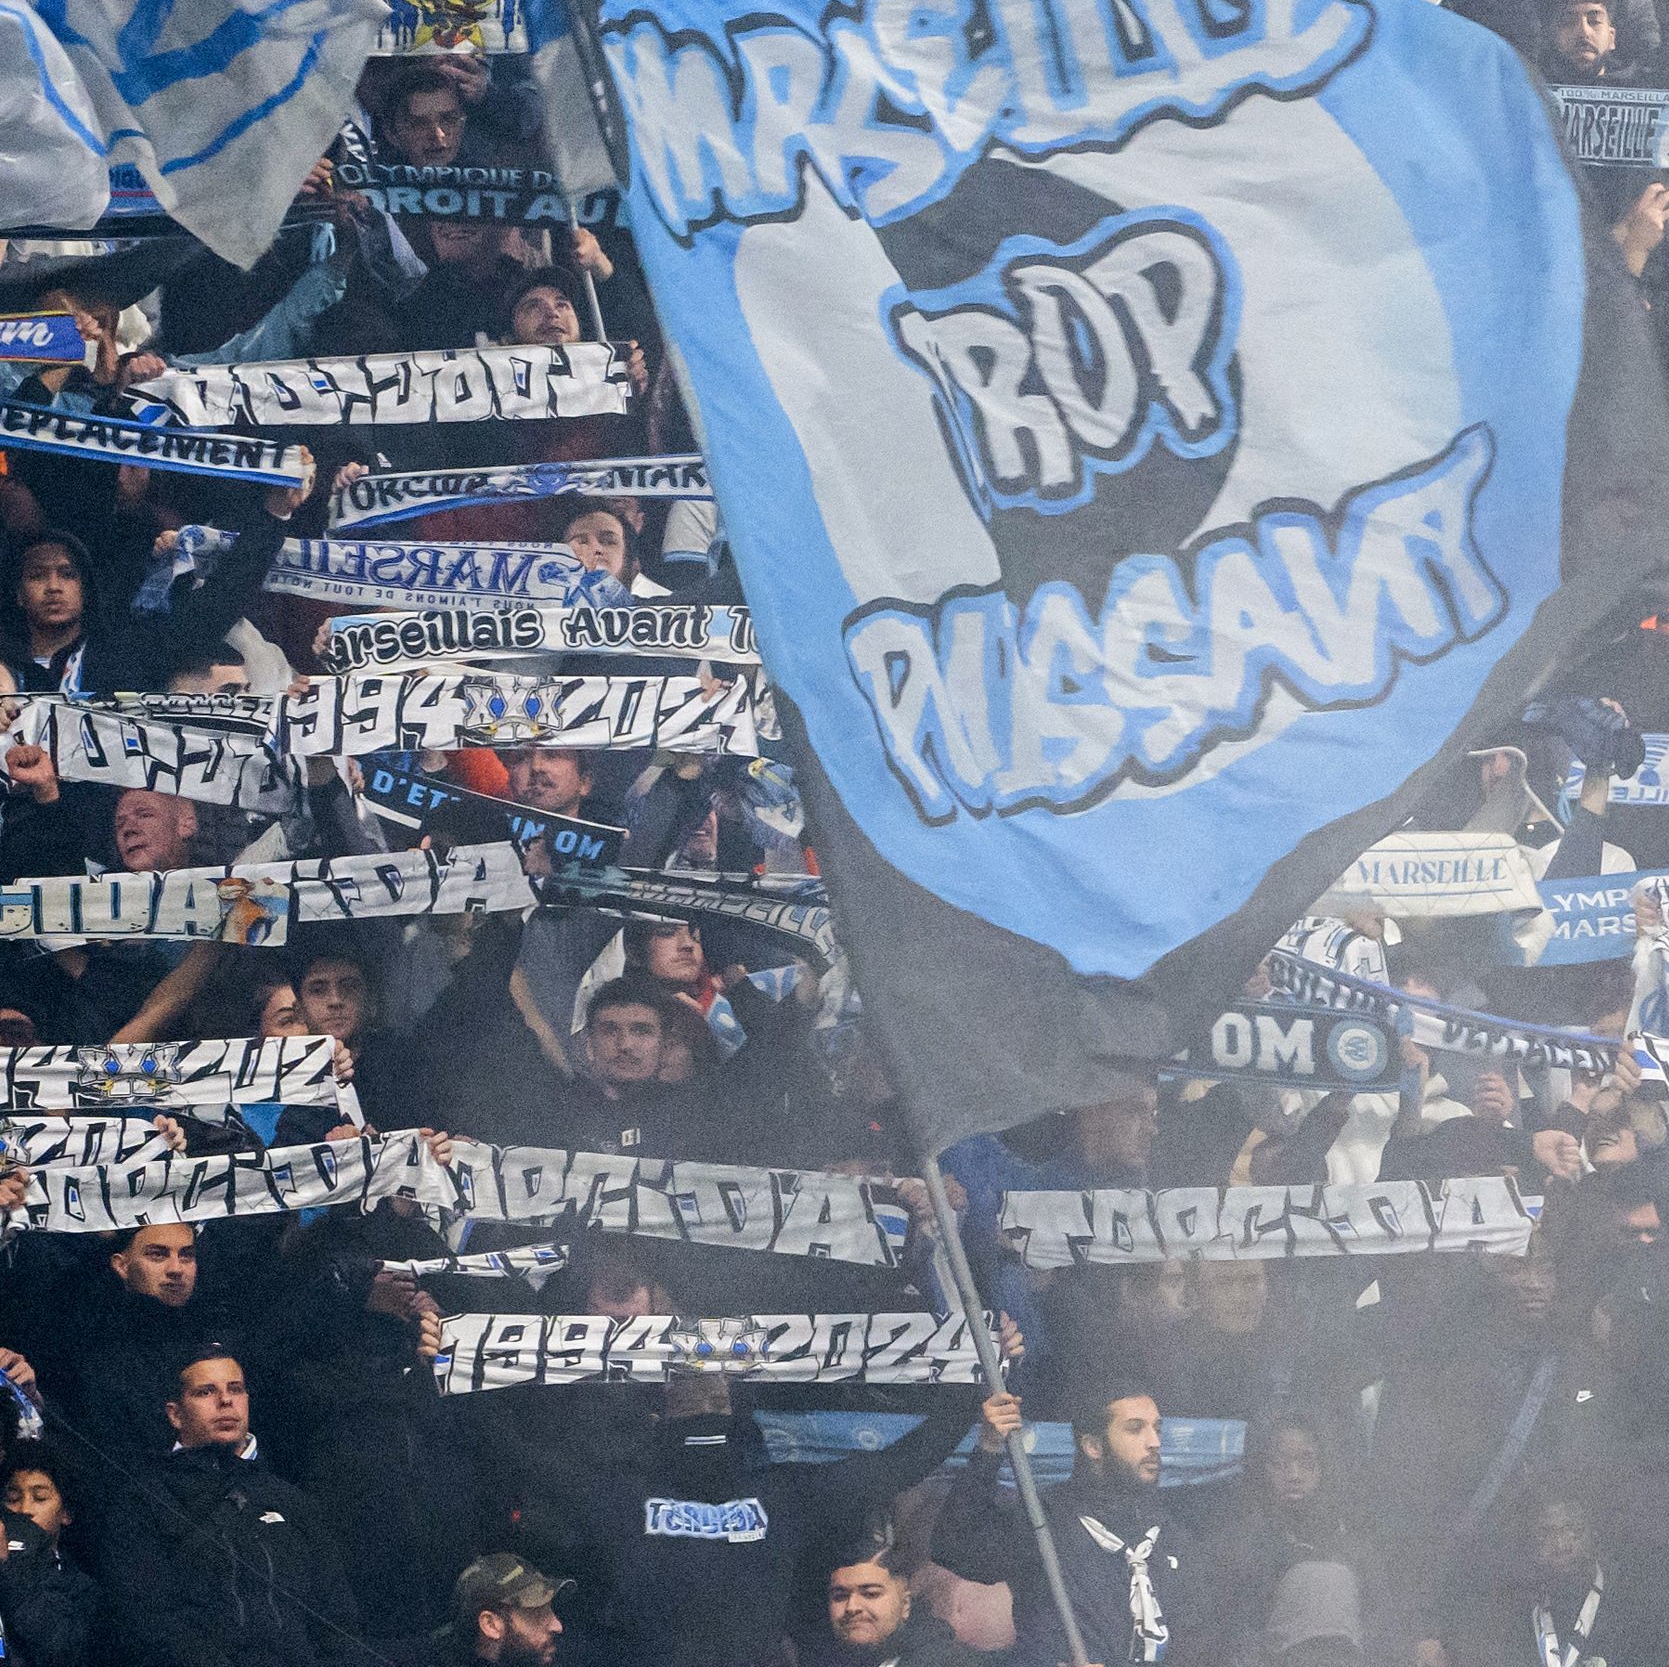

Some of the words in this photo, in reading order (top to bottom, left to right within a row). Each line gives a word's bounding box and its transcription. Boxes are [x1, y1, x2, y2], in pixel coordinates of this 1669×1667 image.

[333, 163, 523, 190] OLYMPIQUE
[363, 188, 512, 217] DROIT
[524, 195, 611, 221] AU
[165, 342, 628, 425] TORCIDA
[565, 604, 710, 648] Avant
[556, 828, 606, 860] OM
[1355, 855, 1508, 885] MARSEILLE
[1212, 1013, 1315, 1073] OM
[1002, 1177, 1537, 1269] TORCIDA
[440, 1313, 675, 1392] 1994
[750, 1310, 1001, 1385] 2024
